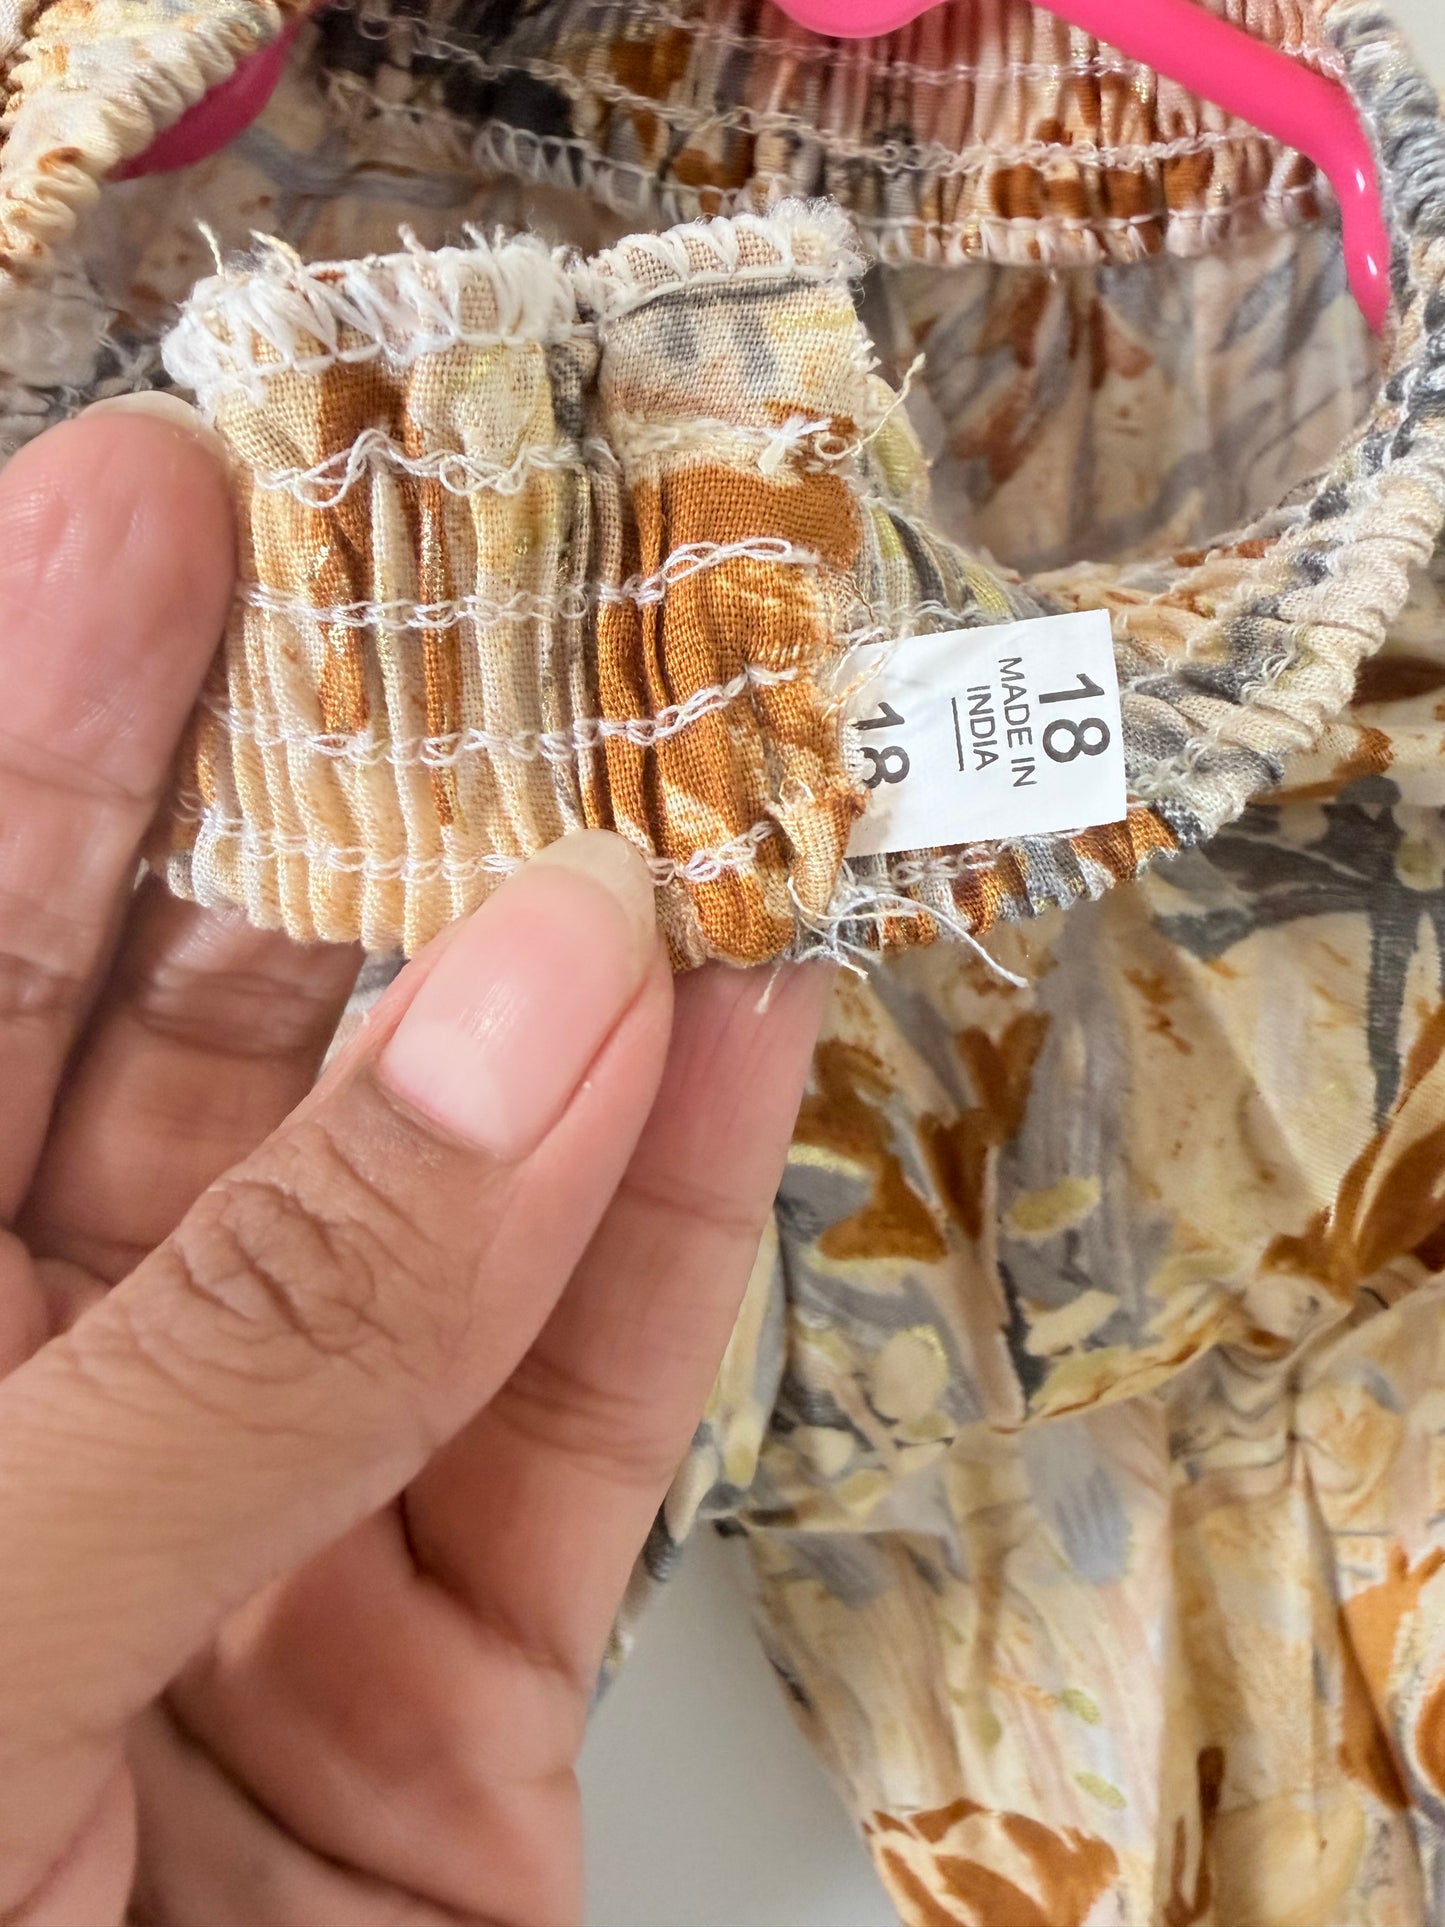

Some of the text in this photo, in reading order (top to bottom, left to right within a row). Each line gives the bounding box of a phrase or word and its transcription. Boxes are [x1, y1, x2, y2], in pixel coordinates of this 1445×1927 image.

[852, 701, 910, 789] 18
[966, 685, 999, 770] INDIA
[998, 656, 1038, 787] MADE IN
[1038, 673, 1111, 763] 18
